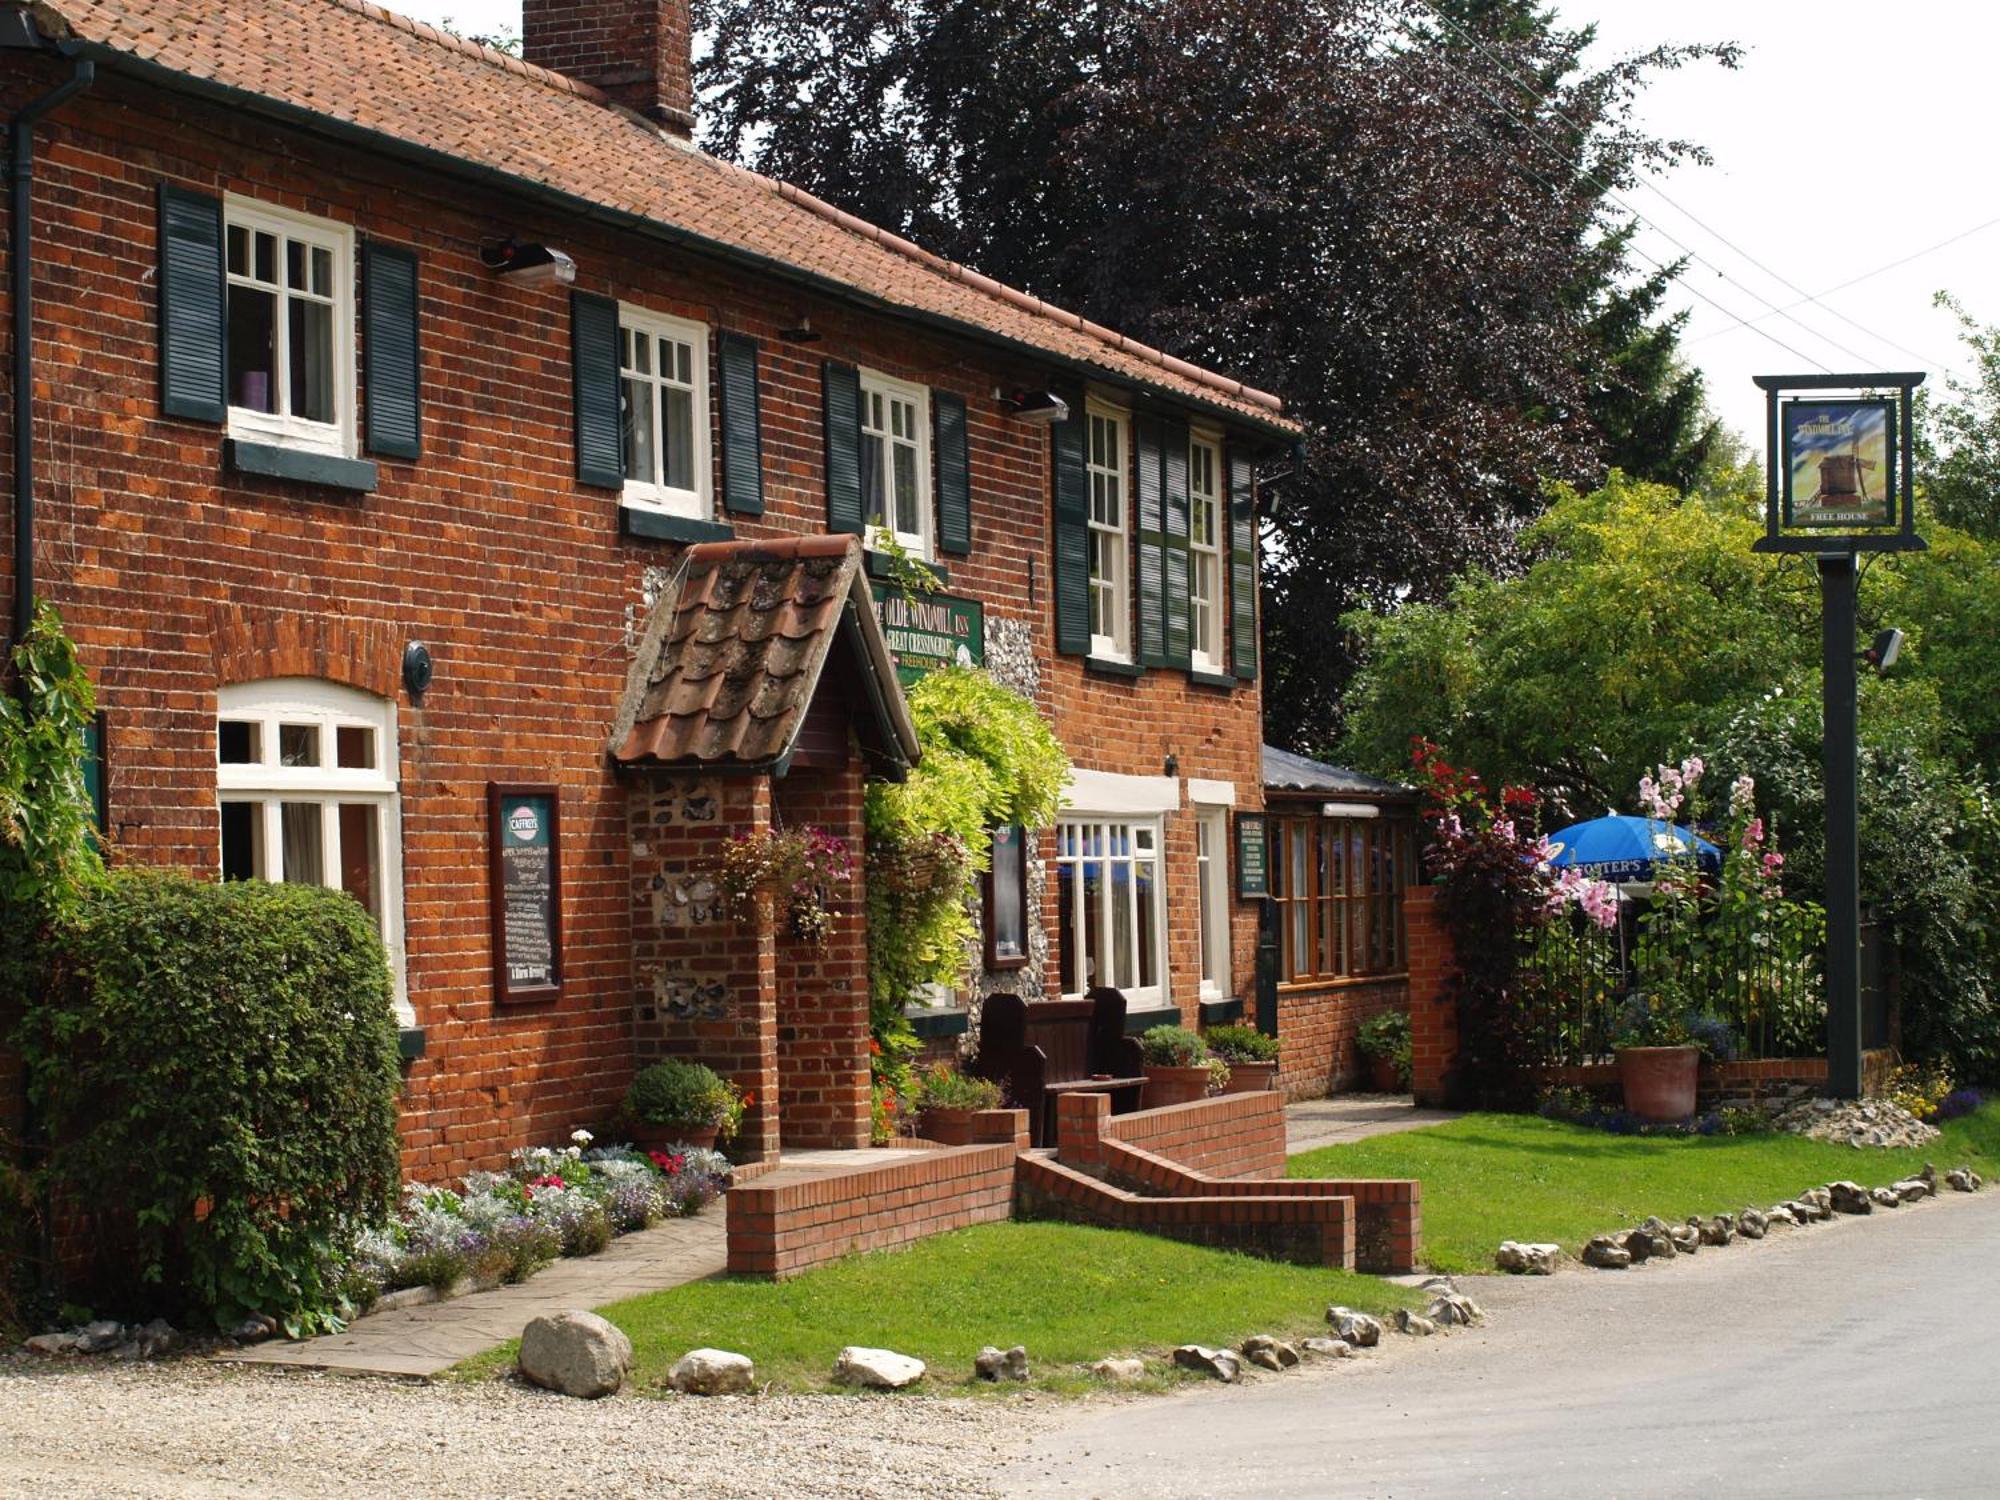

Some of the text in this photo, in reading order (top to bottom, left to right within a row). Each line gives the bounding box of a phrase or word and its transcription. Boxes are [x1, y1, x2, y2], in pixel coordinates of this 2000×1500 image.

[1798, 424, 1834, 434] WINDMILL
[1810, 513, 1868, 521] FREE HOUSE
[885, 598, 909, 628] OLDE
[910, 602, 953, 635] WINDMILL
[955, 614, 969, 638] INN
[886, 630, 908, 652] GREAT
